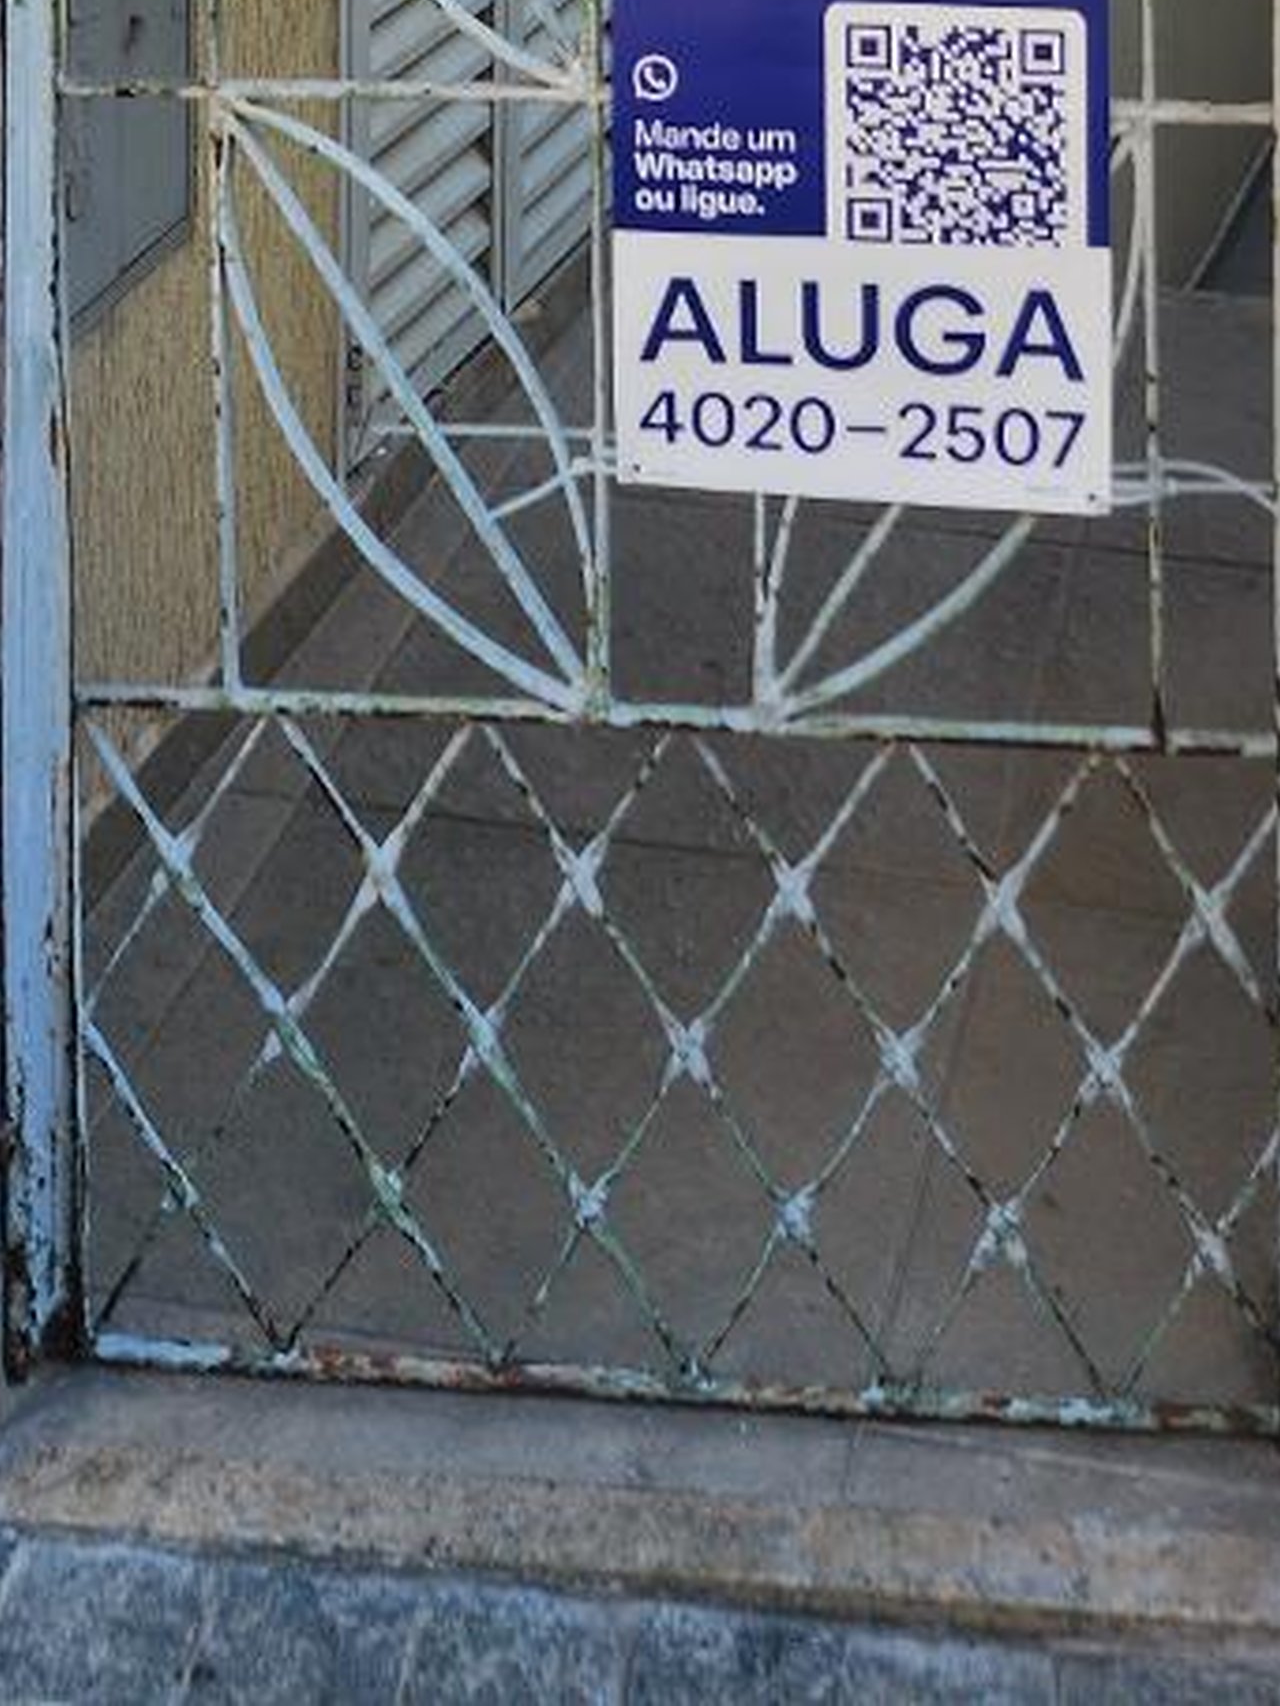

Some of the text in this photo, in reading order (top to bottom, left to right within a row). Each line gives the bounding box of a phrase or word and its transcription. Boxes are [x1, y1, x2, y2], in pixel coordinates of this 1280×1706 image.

[634, 118, 796, 153] Mande um
[634, 151, 799, 190] Whatsapp
[634, 184, 766, 221] ou ligue.
[639, 277, 1085, 382] ALUGA
[639, 390, 1087, 468] 4020-2507
